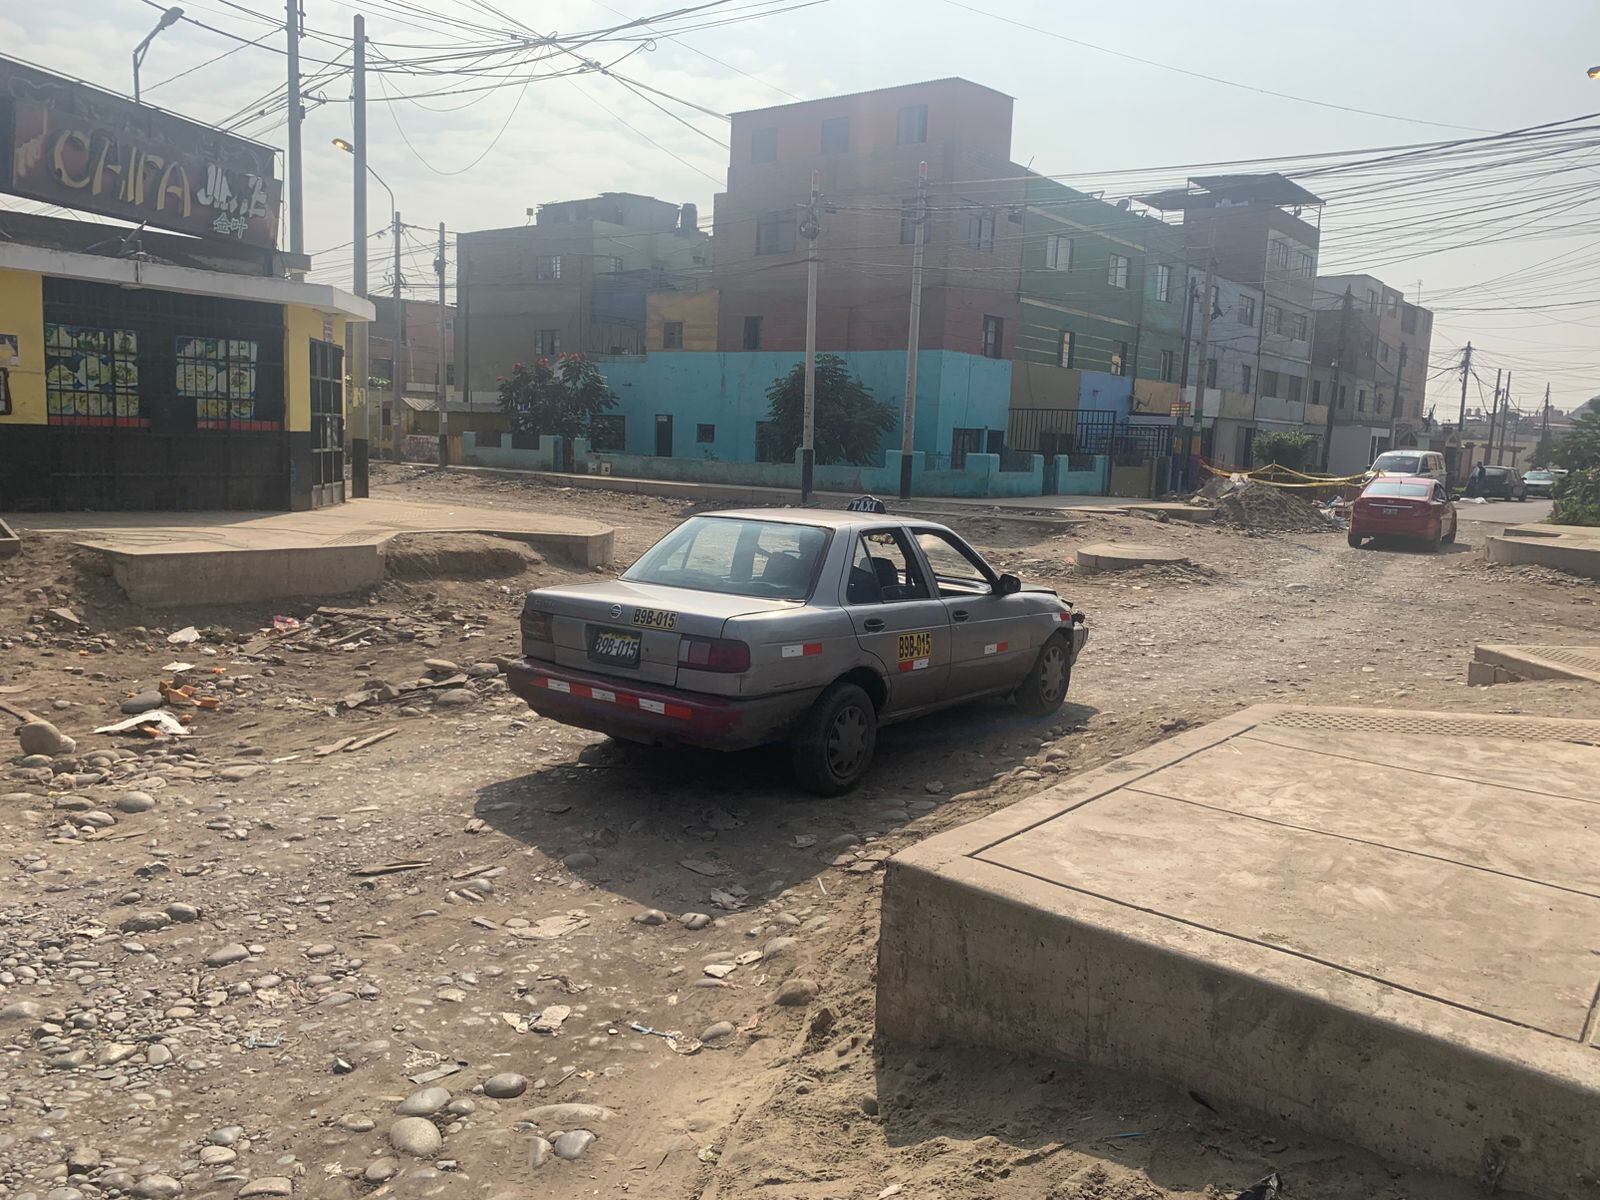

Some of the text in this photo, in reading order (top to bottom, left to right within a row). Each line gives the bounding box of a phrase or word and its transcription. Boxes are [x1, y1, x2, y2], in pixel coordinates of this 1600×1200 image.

[852, 500, 877, 512] TAXI
[633, 608, 676, 628] B9B-015
[899, 634, 931, 658] B9B-015
